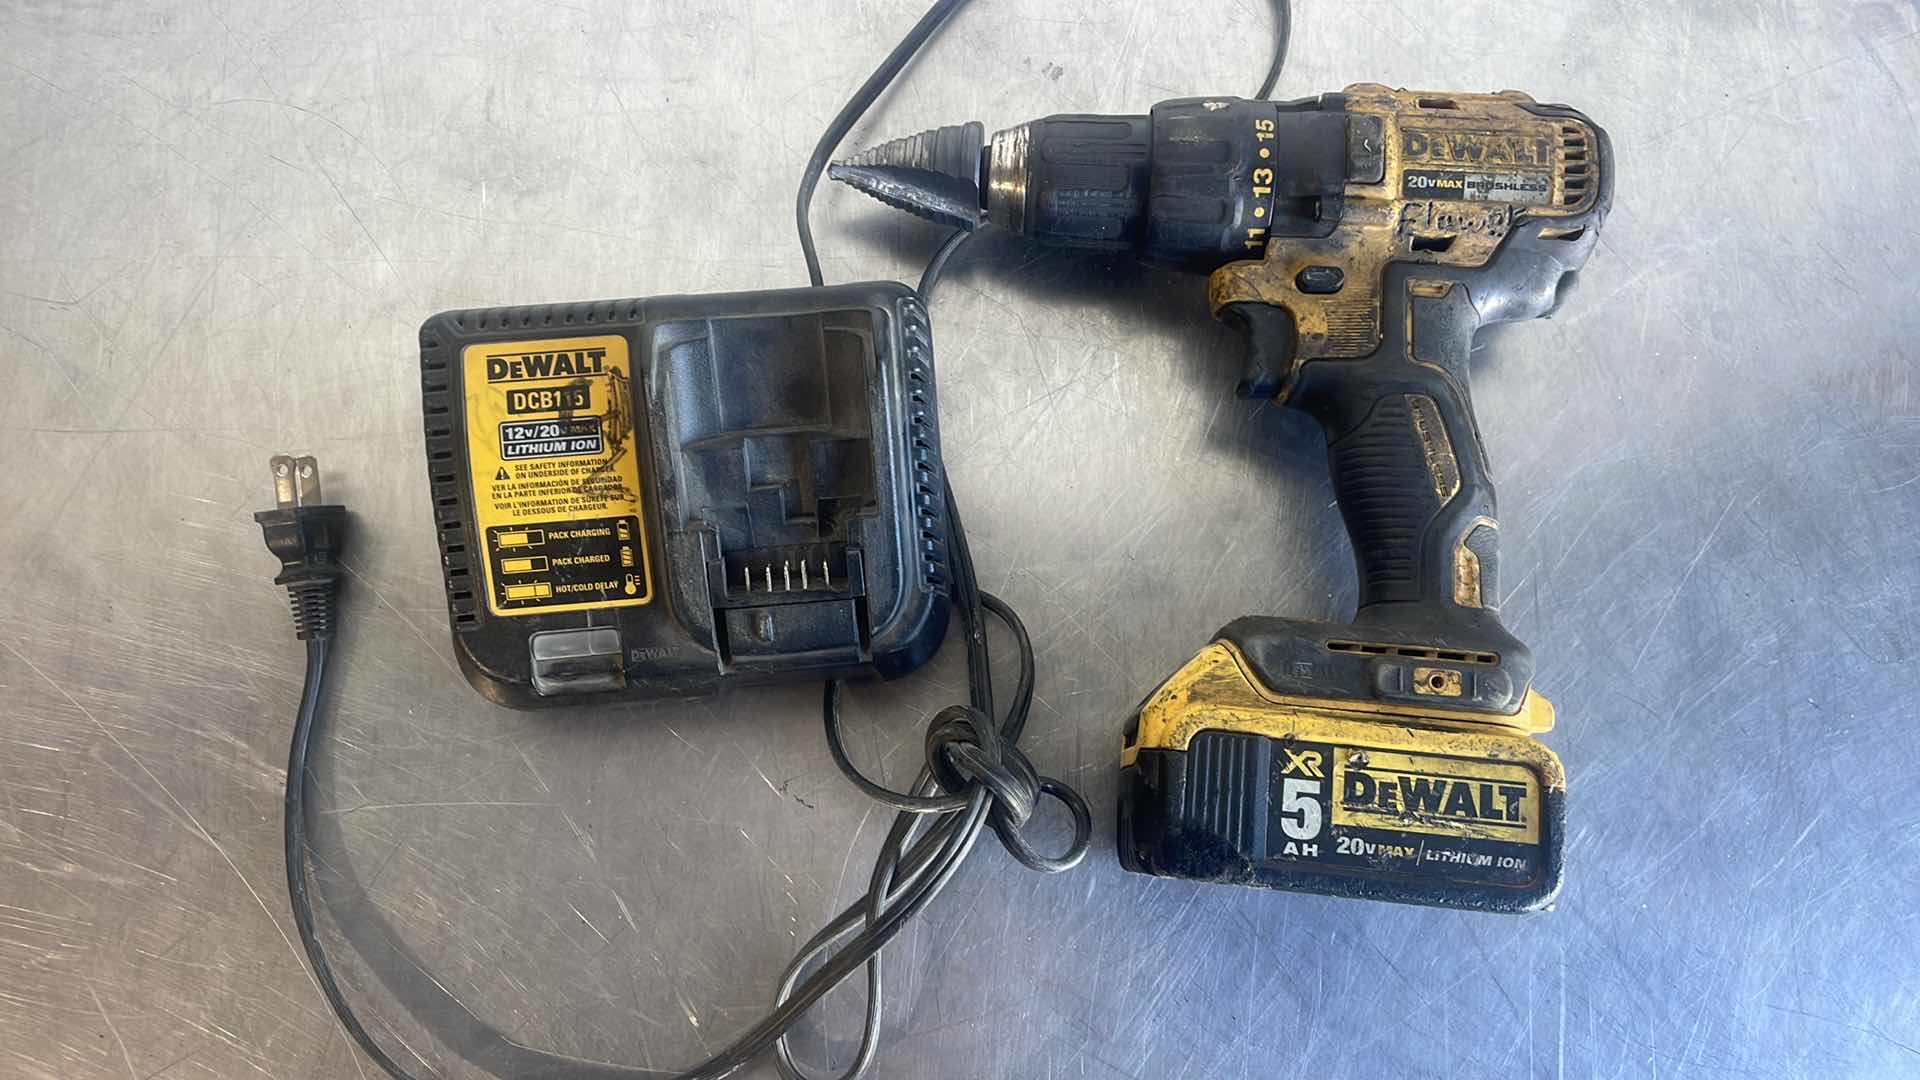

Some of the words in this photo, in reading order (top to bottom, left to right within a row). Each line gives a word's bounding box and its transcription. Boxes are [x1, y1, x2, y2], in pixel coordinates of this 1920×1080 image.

[1255, 119, 1274, 142] 15
[1253, 168, 1273, 198] 13
[1467, 181, 1547, 192] BRUSHLESS
[1245, 227, 1266, 249] 11
[507, 442, 567, 455] LITHIUM
[570, 440, 597, 451] ION
[529, 461, 556, 470] SAFETY
[558, 458, 608, 468] INFORMATION
[515, 471, 527, 479] ON
[528, 469, 568, 478] UNDERSIDE
[570, 467, 579, 475] OF
[491, 492, 502, 500] EN
[503, 491, 513, 499] LA
[514, 489, 537, 498] PARTE
[538, 487, 571, 497] INFERIOR
[494, 502, 511, 510] VOIR
[512, 508, 521, 516] LE
[522, 506, 556, 515] DESSOUS
[548, 530, 569, 540] PACK
[570, 527, 611, 538] CHARGING
[552, 557, 573, 566] PACK
[573, 554, 610, 565] CHARGED
[556, 583, 593, 593] HOT/COLD
[594, 580, 619, 590] DELAY
[1281, 750, 1326, 778] XR
[1281, 777, 1322, 840] 5
[1426, 849, 1492, 867] LITHIUM
[1497, 856, 1527, 871] ION
